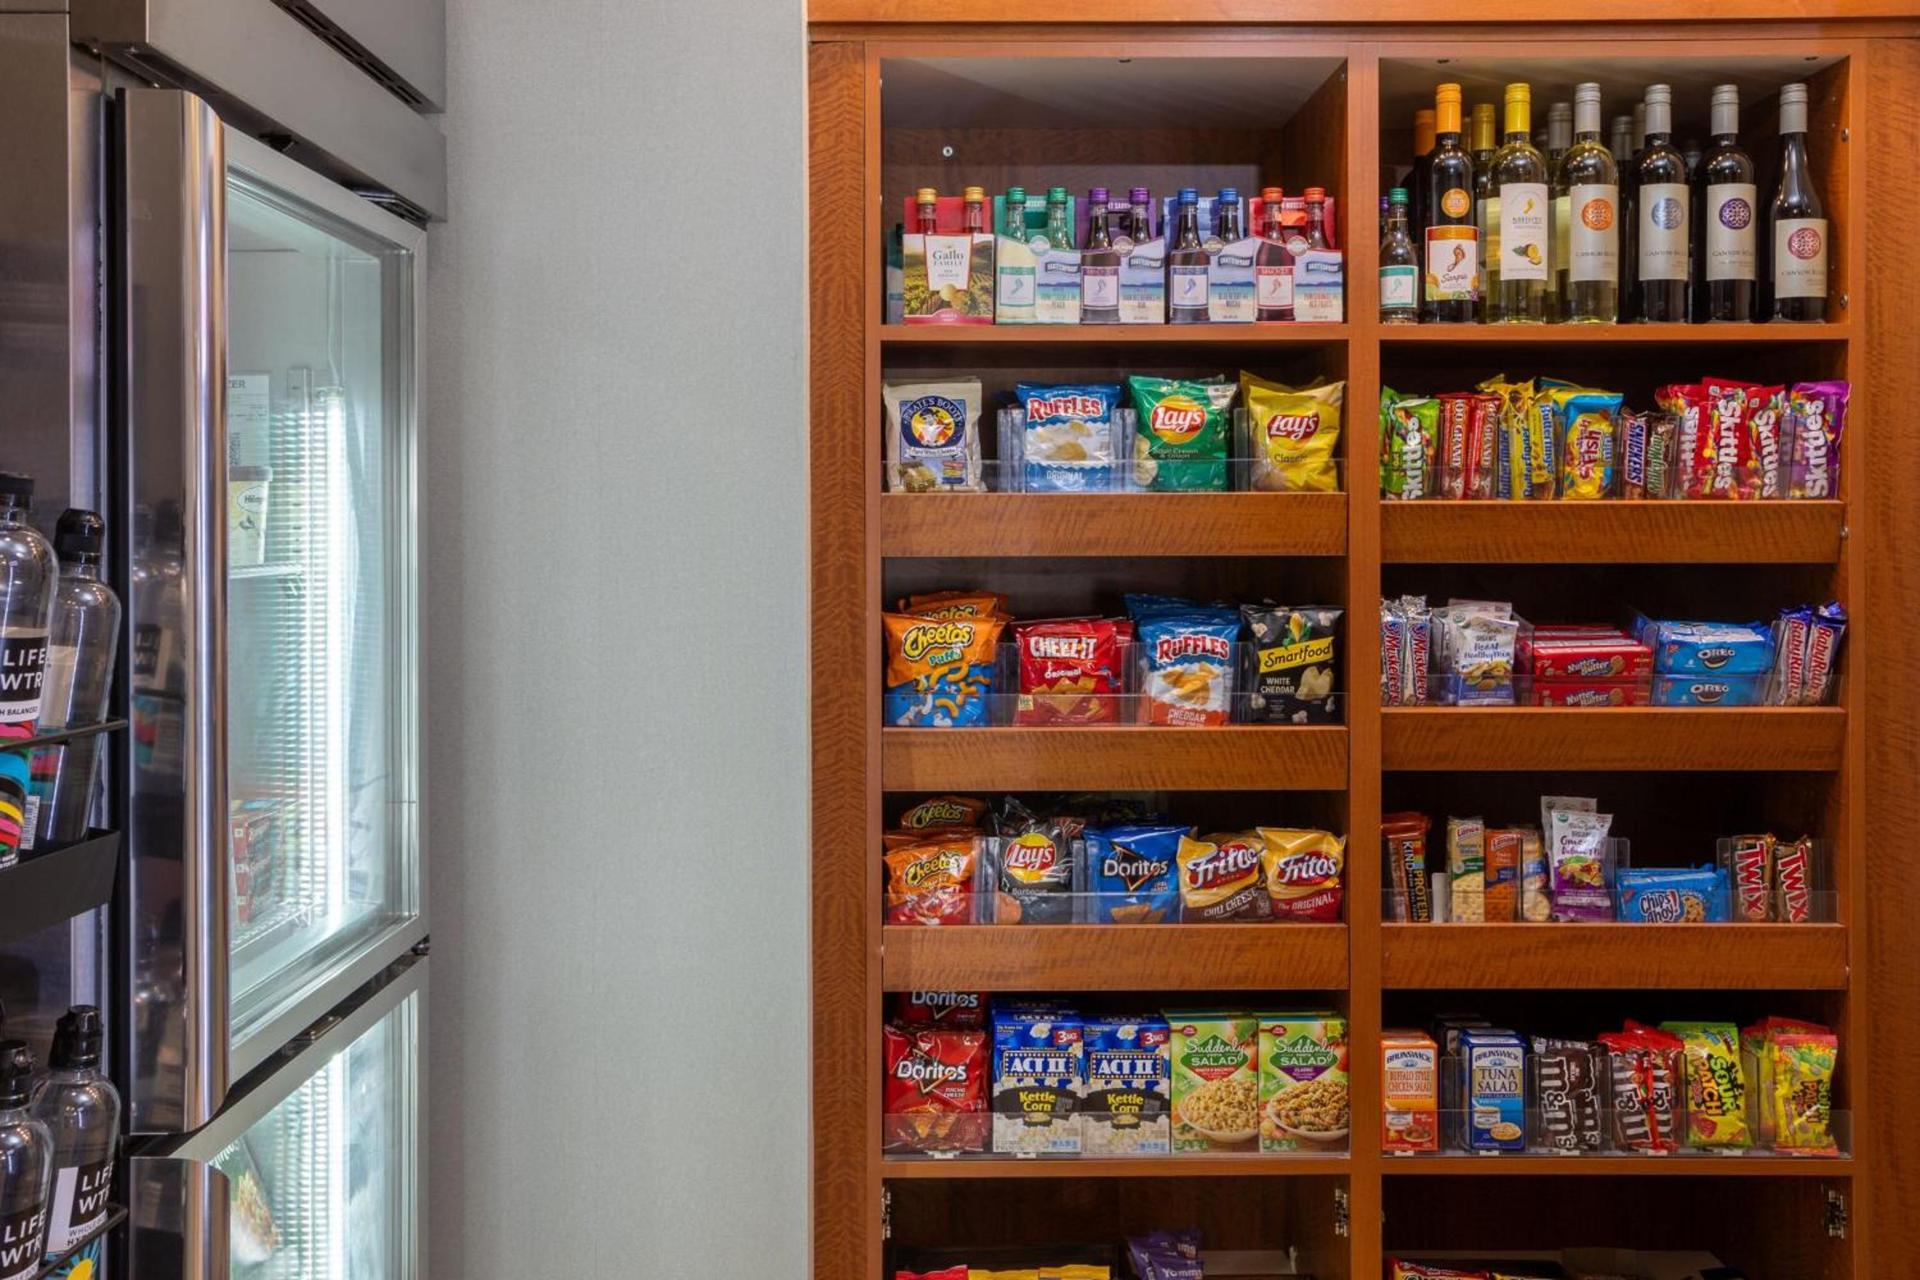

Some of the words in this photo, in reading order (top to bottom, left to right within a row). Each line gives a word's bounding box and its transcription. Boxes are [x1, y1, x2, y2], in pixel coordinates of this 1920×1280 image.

[932, 250, 964, 260] Gallo
[1028, 396, 1103, 421] RUFFLES
[1155, 405, 1201, 432] Lay's
[1270, 411, 1320, 439] Lay's
[1174, 447, 1199, 456] Cream
[1628, 424, 1645, 483] SNICKERS
[1714, 400, 1742, 489] Skittles
[1754, 409, 1778, 498] Skittles
[1801, 400, 1829, 497] Skittles
[1047, 470, 1085, 481] ORIGINAL
[903, 623, 974, 659] Cheetos
[1156, 635, 1230, 662] RUFFLES
[3, 648, 46, 666] LIFE
[1264, 642, 1331, 668] Smartfood
[1697, 649, 1735, 659] OREO
[1567, 658, 1594, 674] Nutter
[0, 672, 43, 690] WTR
[1261, 685, 1296, 694] CHEDDAR
[1266, 677, 1291, 685] WHITE
[1691, 684, 1729, 693] OREO
[1167, 708, 1207, 722] CHEDDAR
[911, 802, 964, 828] Cheetos
[1007, 845, 1054, 870] Lay's
[1403, 841, 1415, 870] KIND
[905, 852, 961, 886] Cheetos
[1104, 858, 1168, 877] Doritos
[1278, 851, 1337, 884] Fritos
[1736, 841, 1767, 919] TWIX
[1779, 845, 1808, 922] TWIX
[1225, 888, 1259, 912] CHEESE
[1291, 893, 1335, 909] ORIGINAL
[1414, 871, 1428, 921] PROTEIN
[1641, 894, 1671, 914] Chips
[912, 990, 978, 1007] Doritos
[1184, 1037, 1245, 1061] Suddenly
[1274, 1037, 1335, 1061] Suddenly
[1387, 1050, 1432, 1064] BRUNSWICK
[1475, 1050, 1520, 1064] BRUNSWICK
[897, 1061, 967, 1081] Doritos
[1011, 1058, 1044, 1072] ACT
[1048, 1058, 1066, 1072] II
[1099, 1059, 1131, 1074] ACT
[1134, 1059, 1153, 1073] II
[1191, 1056, 1237, 1066] SALAD
[1280, 1056, 1327, 1066] SALAD
[1481, 1069, 1516, 1080] TUNA
[1709, 1056, 1736, 1111] SOUR
[1478, 1081, 1518, 1092] SALAD
[1700, 1058, 1723, 1116] PATCH
[1019, 1092, 1056, 1103] Kettle
[1023, 1103, 1052, 1112] Corn
[1107, 1094, 1144, 1105] Kettle
[1818, 1080, 1831, 1124] SOUR
[1111, 1104, 1139, 1114] Corn
[4, 1208, 46, 1243] LIFE
[1, 1234, 41, 1268] WTR
